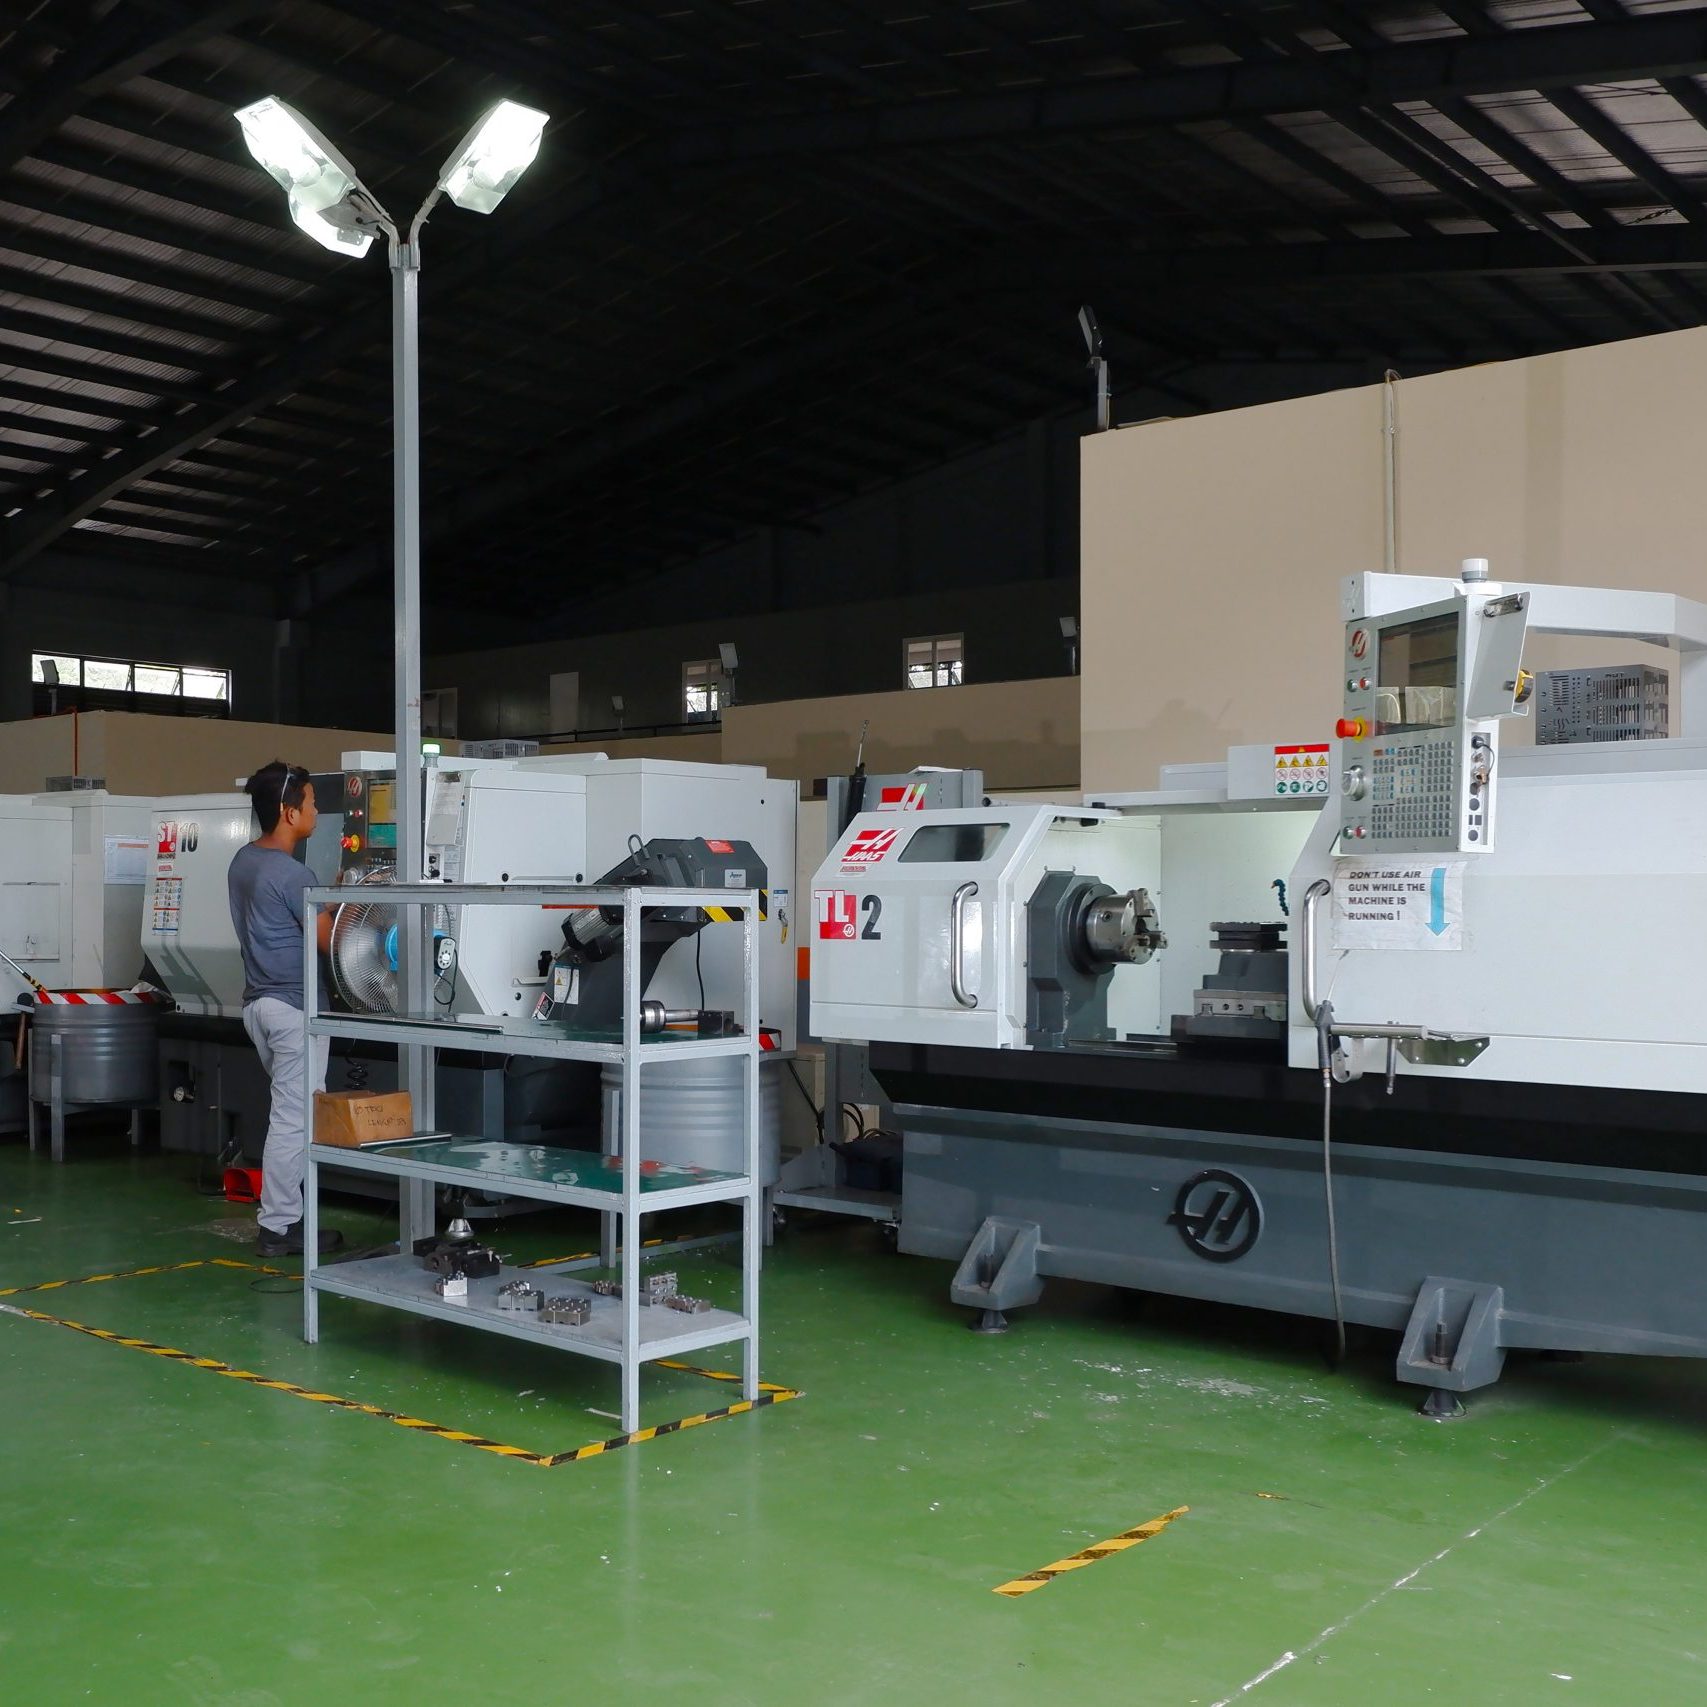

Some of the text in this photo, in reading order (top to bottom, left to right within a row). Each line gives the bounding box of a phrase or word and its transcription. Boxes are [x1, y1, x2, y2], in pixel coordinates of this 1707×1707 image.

[180, 822, 199, 852] 10
[1349, 870, 1422, 879] DON'T USE AIR
[1348, 883, 1426, 892] GUN WHILE THE
[1348, 896, 1407, 905] MACHINE IS
[814, 889, 882, 940] TL 2
[1348, 912, 1394, 921] RUNNING
